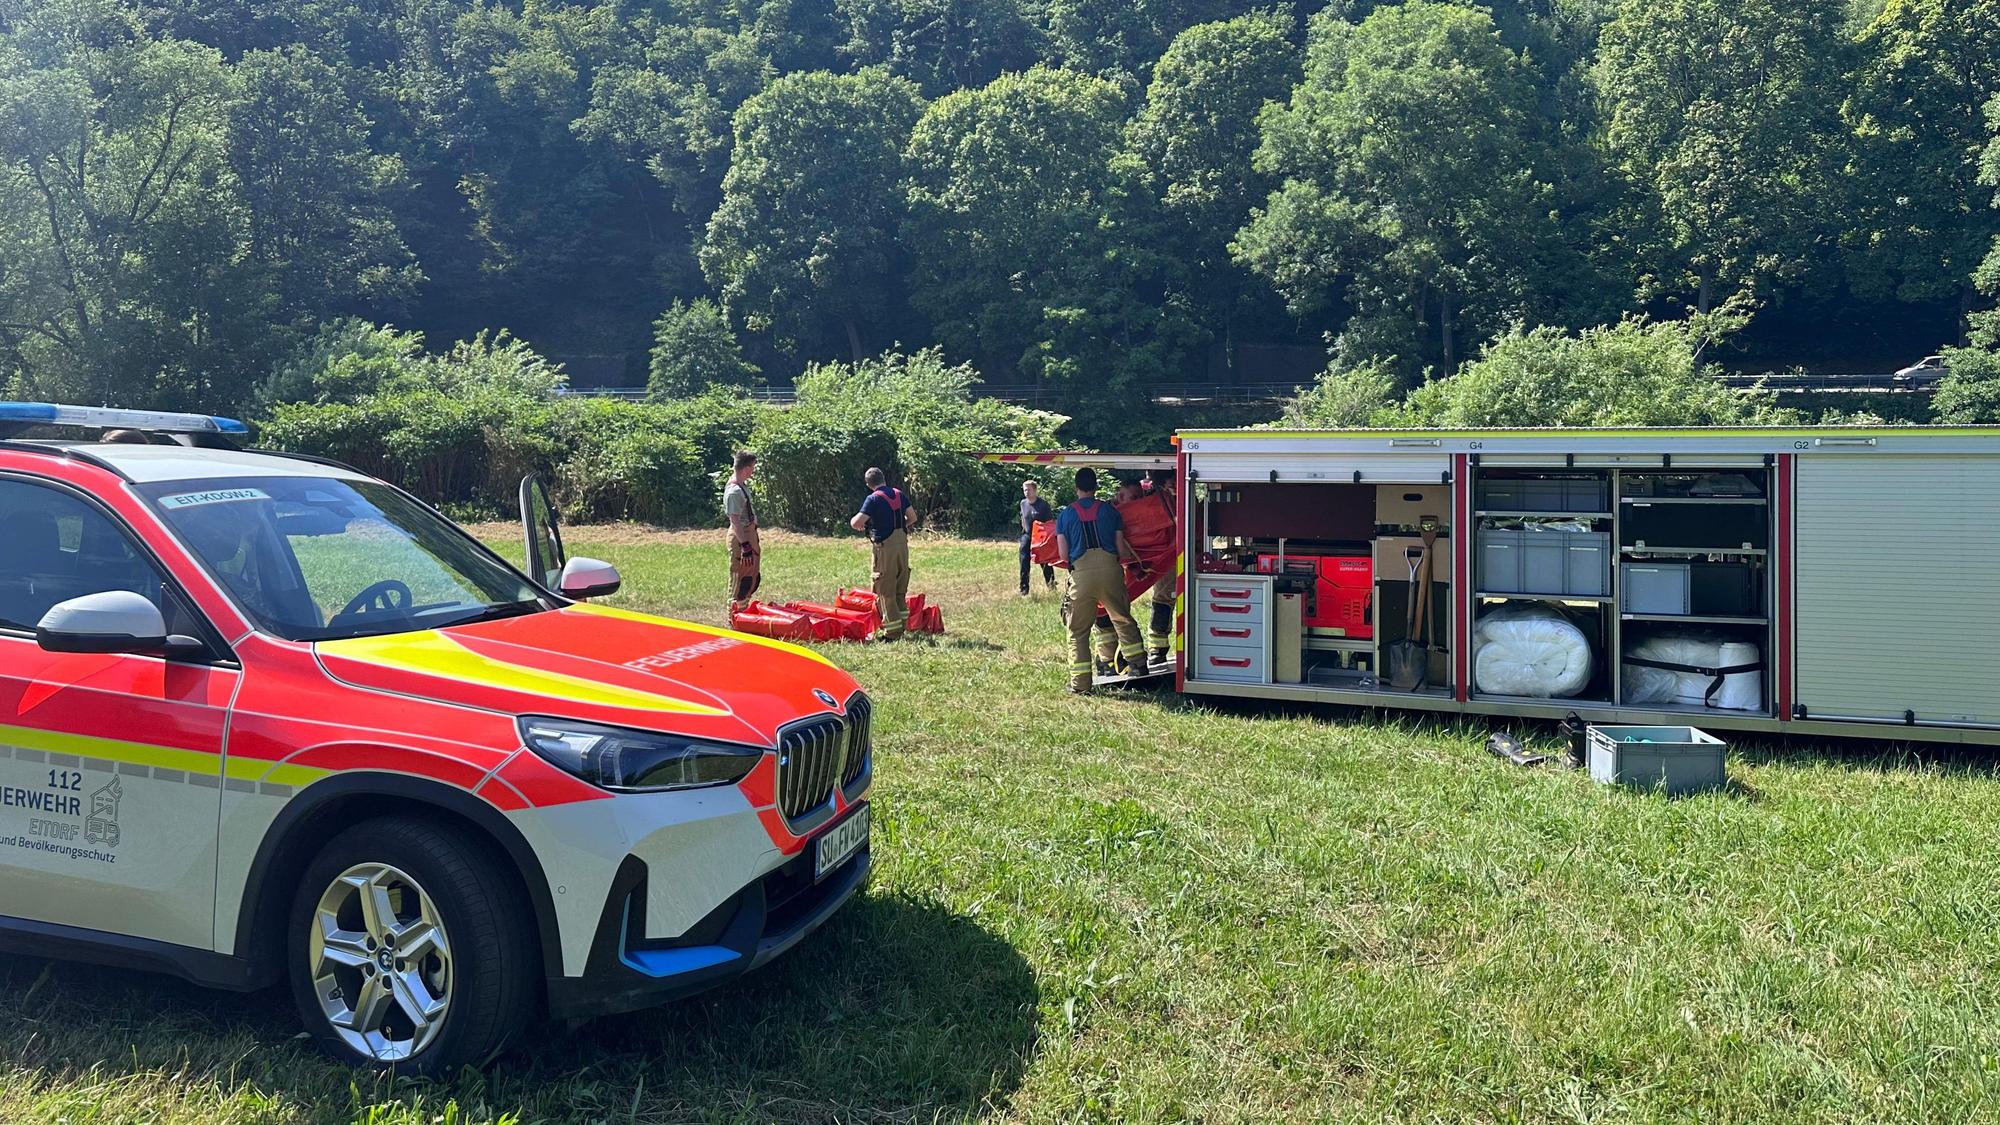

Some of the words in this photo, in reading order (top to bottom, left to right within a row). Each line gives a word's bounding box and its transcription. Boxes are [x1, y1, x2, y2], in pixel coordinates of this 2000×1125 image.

[1187, 442, 1199, 450] G6
[1470, 441, 1483, 450] G4
[1794, 440, 1809, 450] G2
[175, 490, 257, 505] EIT-KDOW-2
[48, 769, 82, 791] 112
[0, 785, 81, 816] ERWEHR
[29, 818, 80, 841] EITORF
[19, 836, 117, 863] Bevölkerungsschutz
[821, 835, 834, 868] SU
